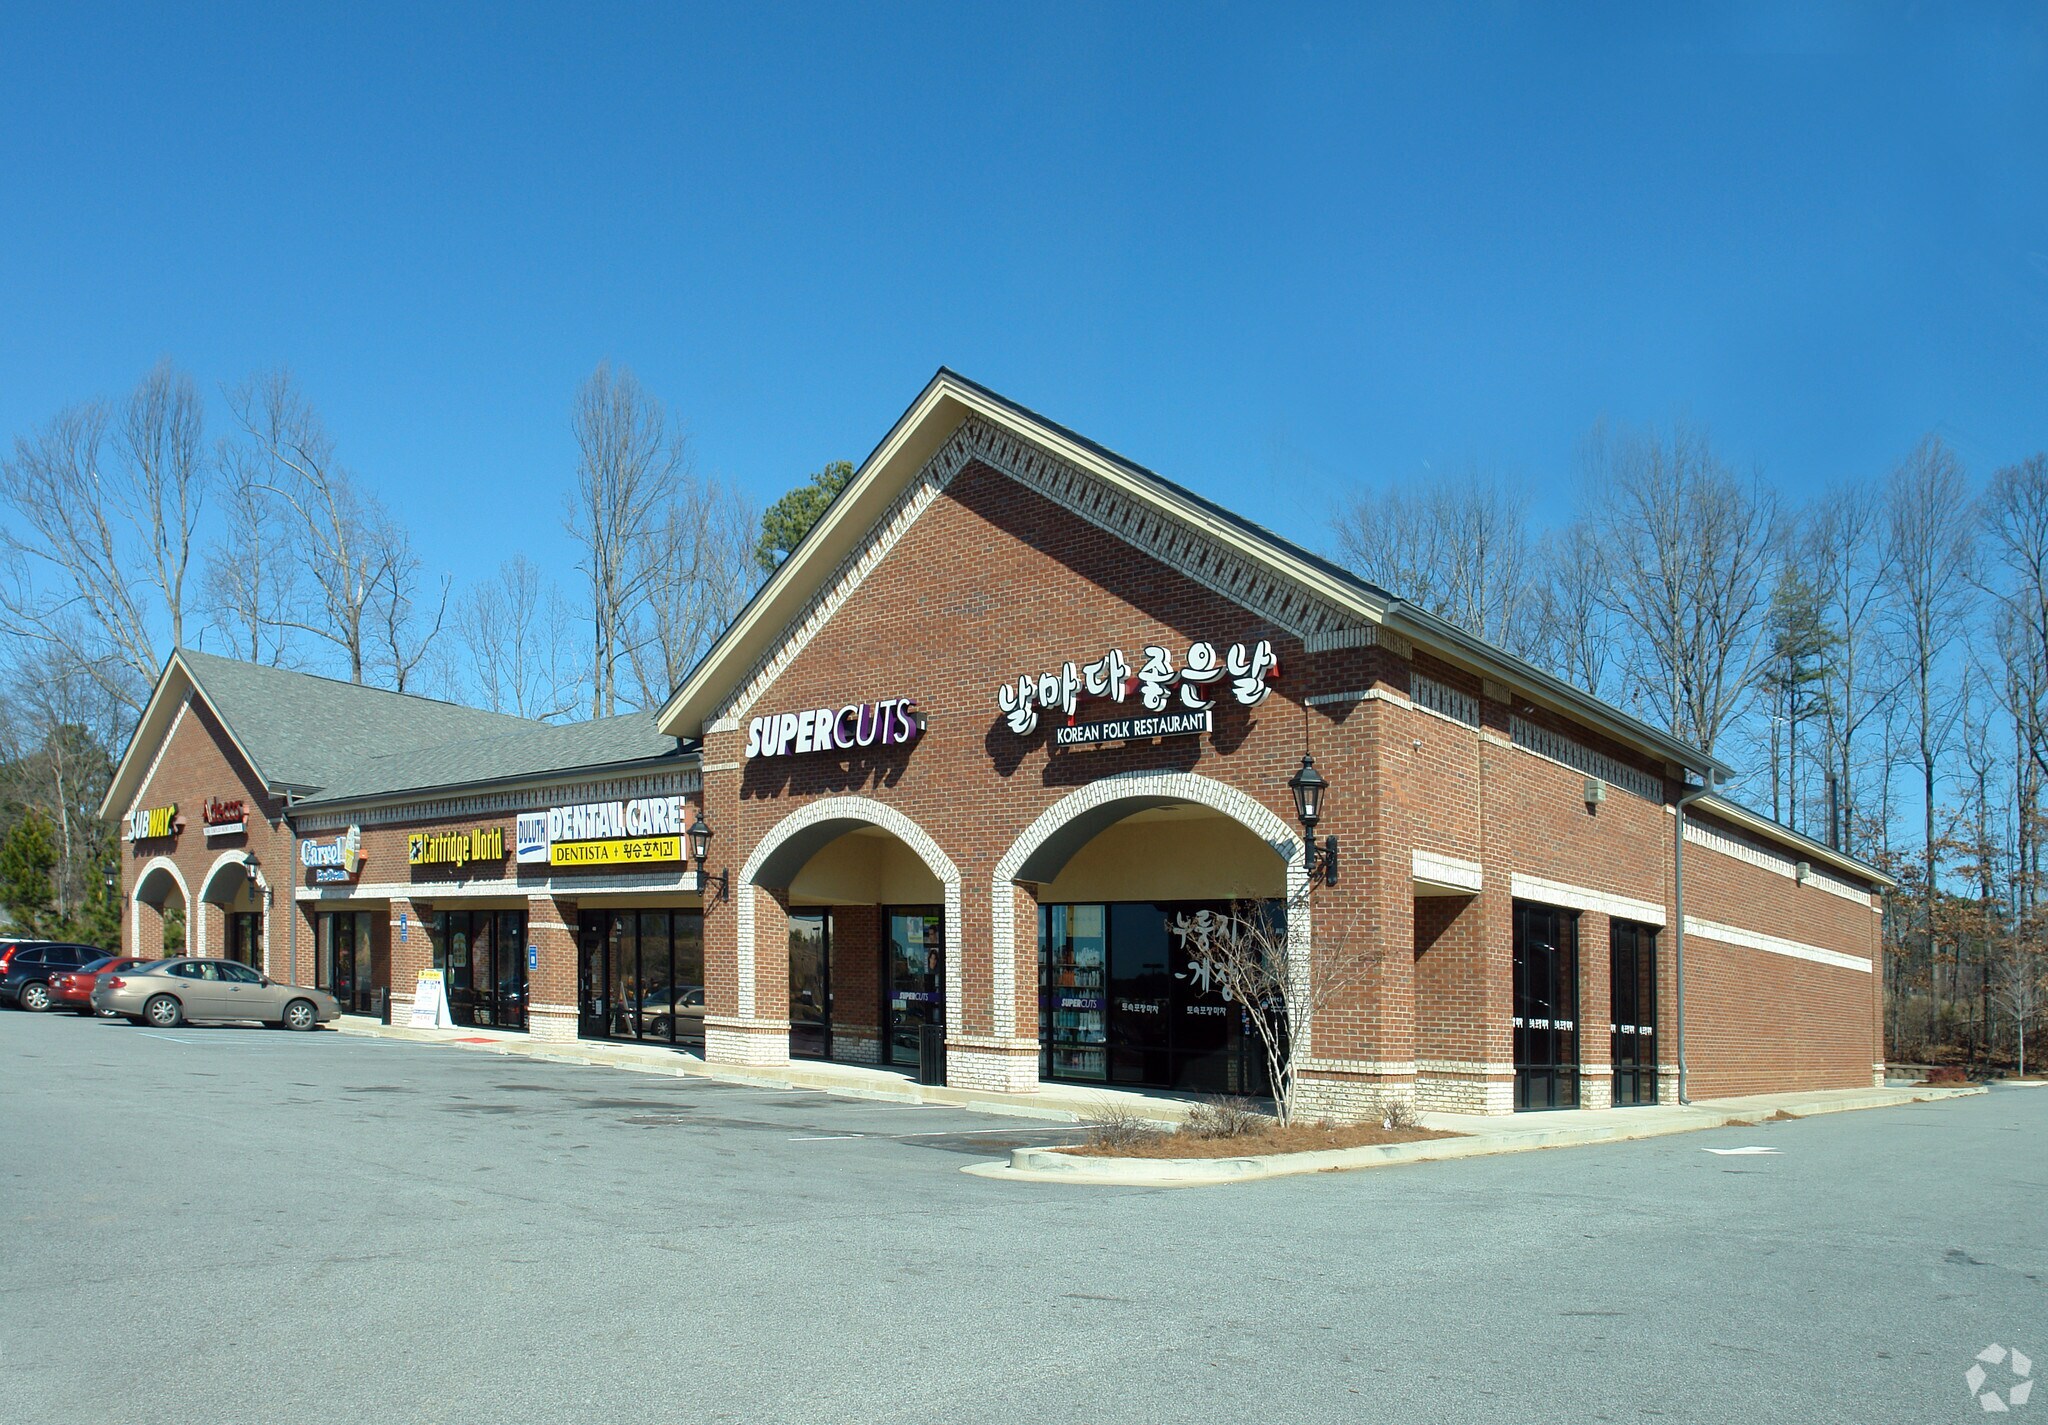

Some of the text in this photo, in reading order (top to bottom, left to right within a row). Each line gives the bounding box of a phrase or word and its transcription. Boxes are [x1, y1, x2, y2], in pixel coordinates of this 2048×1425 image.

[744, 698, 911, 758] SUPERCUTS
[1056, 712, 1205, 745] KOREAN FOLK RESTAURANT
[127, 803, 176, 841] SUBWAY
[518, 818, 546, 844] DULUTH
[550, 796, 682, 841] DENTAL CARE
[301, 836, 346, 868] Carvel
[423, 826, 503, 867] Cartridge World
[556, 844, 609, 862] DENTISTA
[622, 840, 674, 859] 황승호치과
[1061, 998, 1097, 1009] SUPERCUTS
